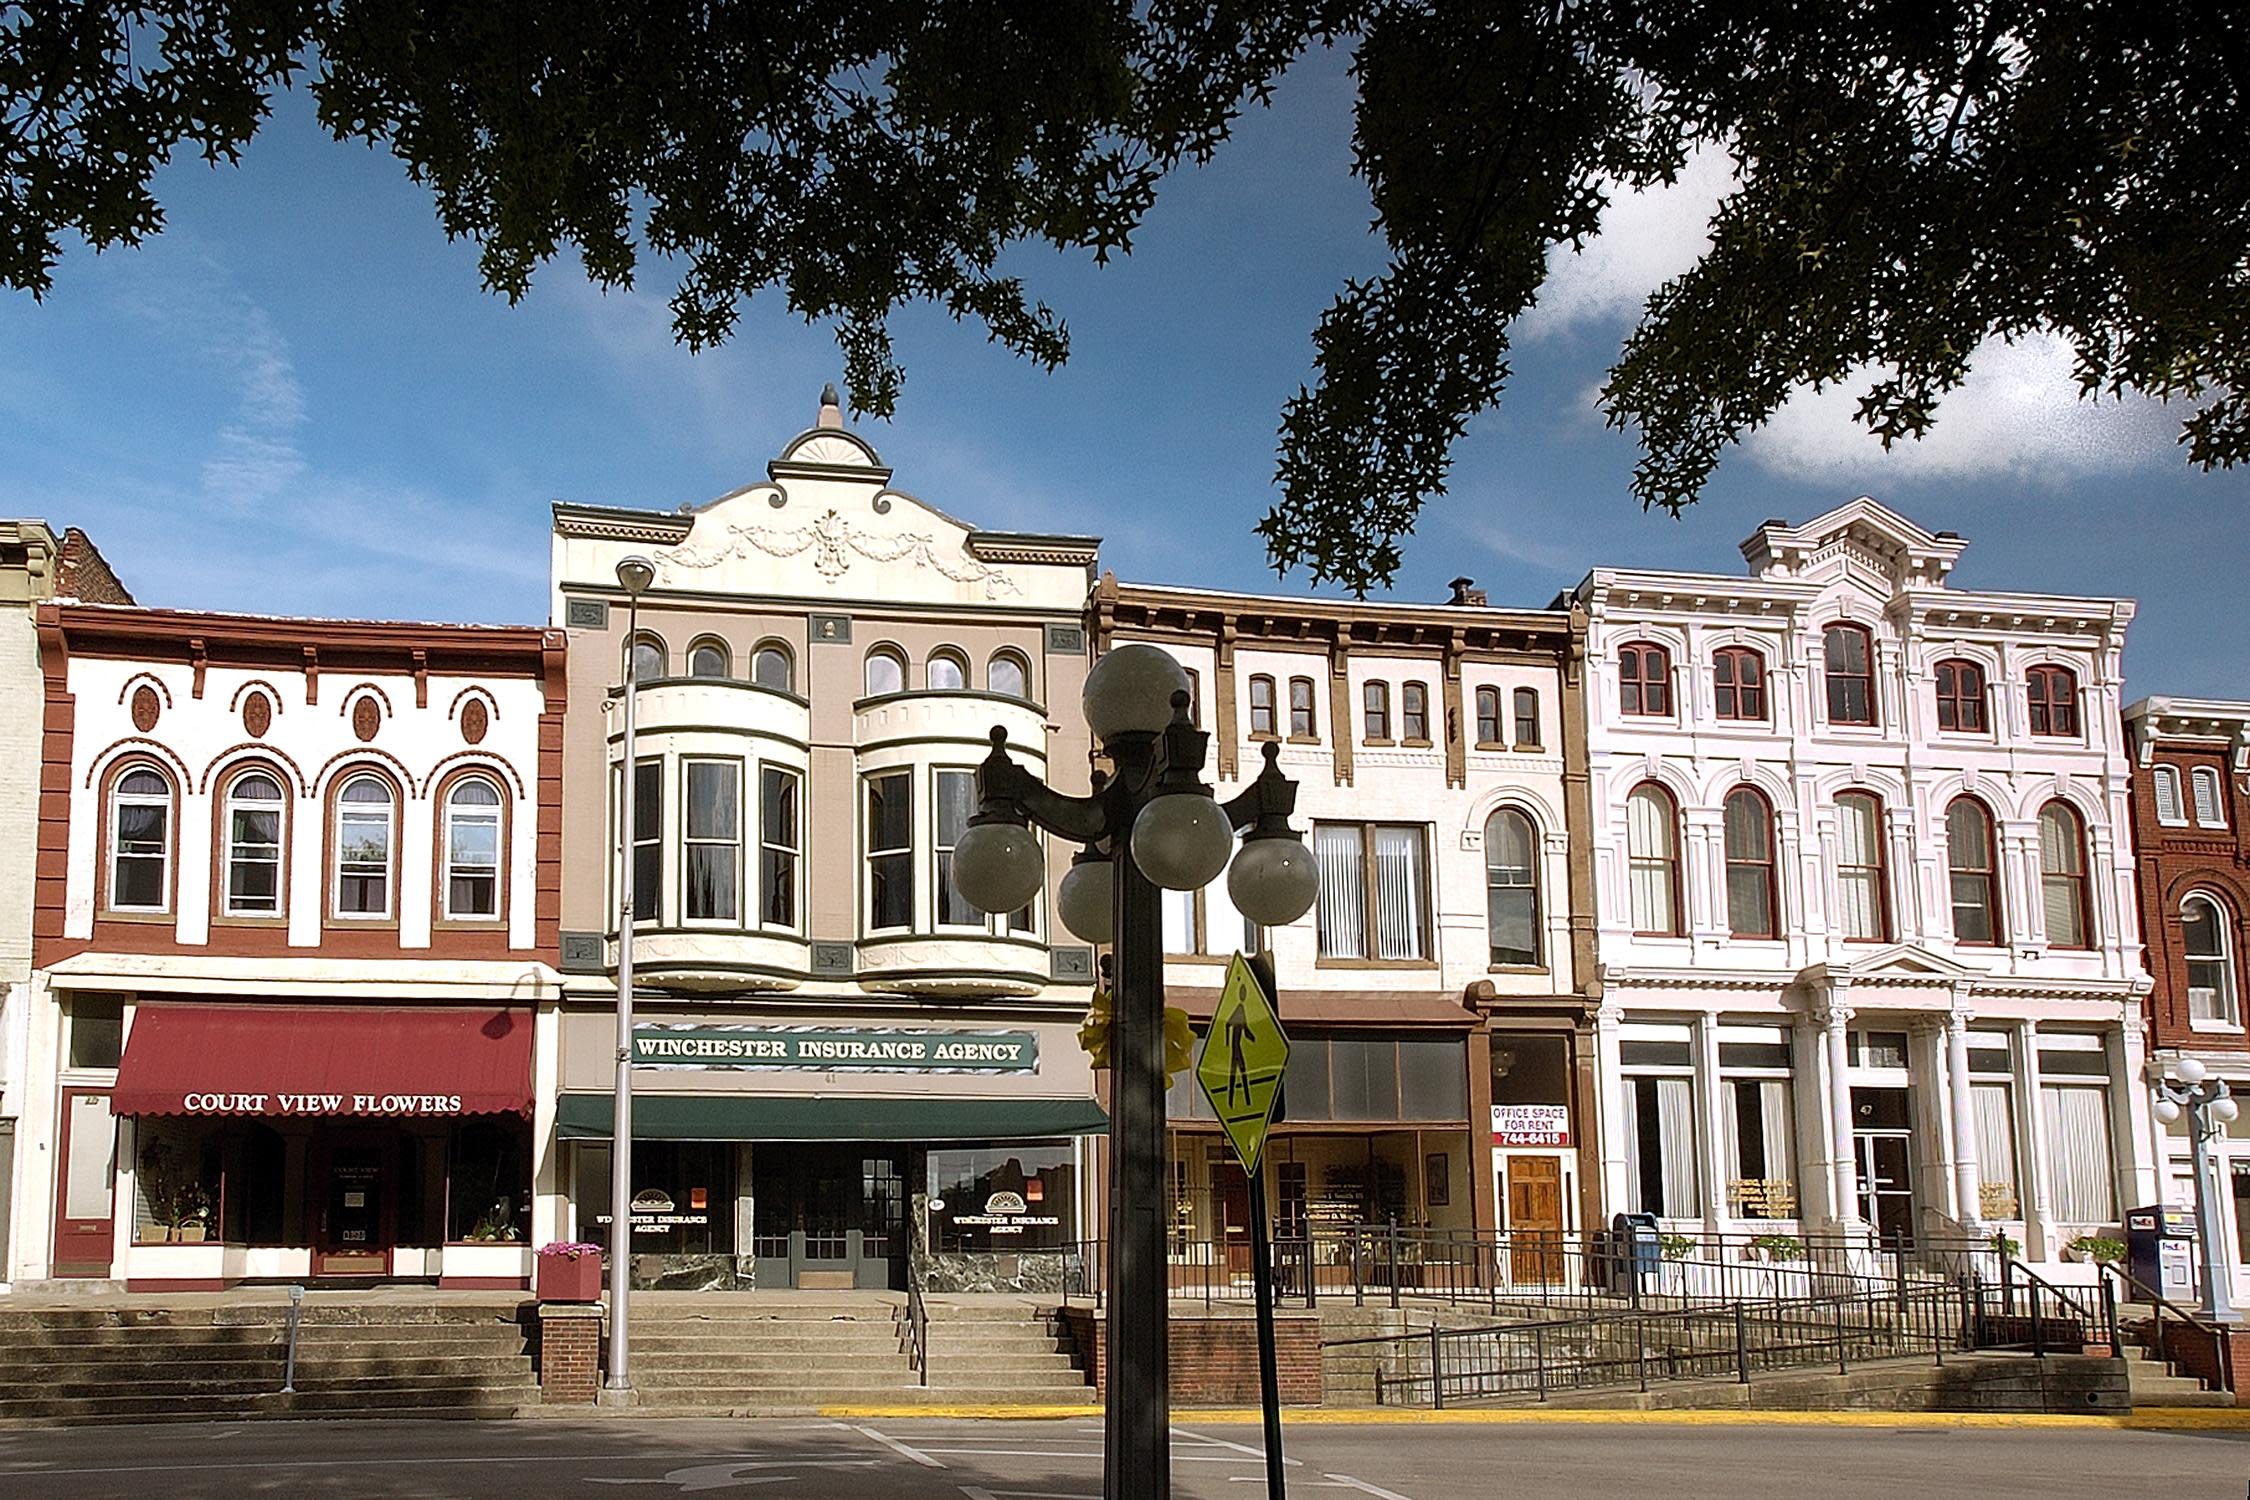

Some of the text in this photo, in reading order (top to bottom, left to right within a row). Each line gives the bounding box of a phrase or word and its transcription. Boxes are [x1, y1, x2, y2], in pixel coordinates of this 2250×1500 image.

[636, 1039, 1022, 1060] WINCHESTER INSURANCE AGENCY
[824, 1074, 836, 1084] 41
[184, 1093, 462, 1112] COURT VIEW FLOWERS
[1493, 1108, 1565, 1119] OFFICE SPACE
[1504, 1120, 1554, 1131] FOR RENT
